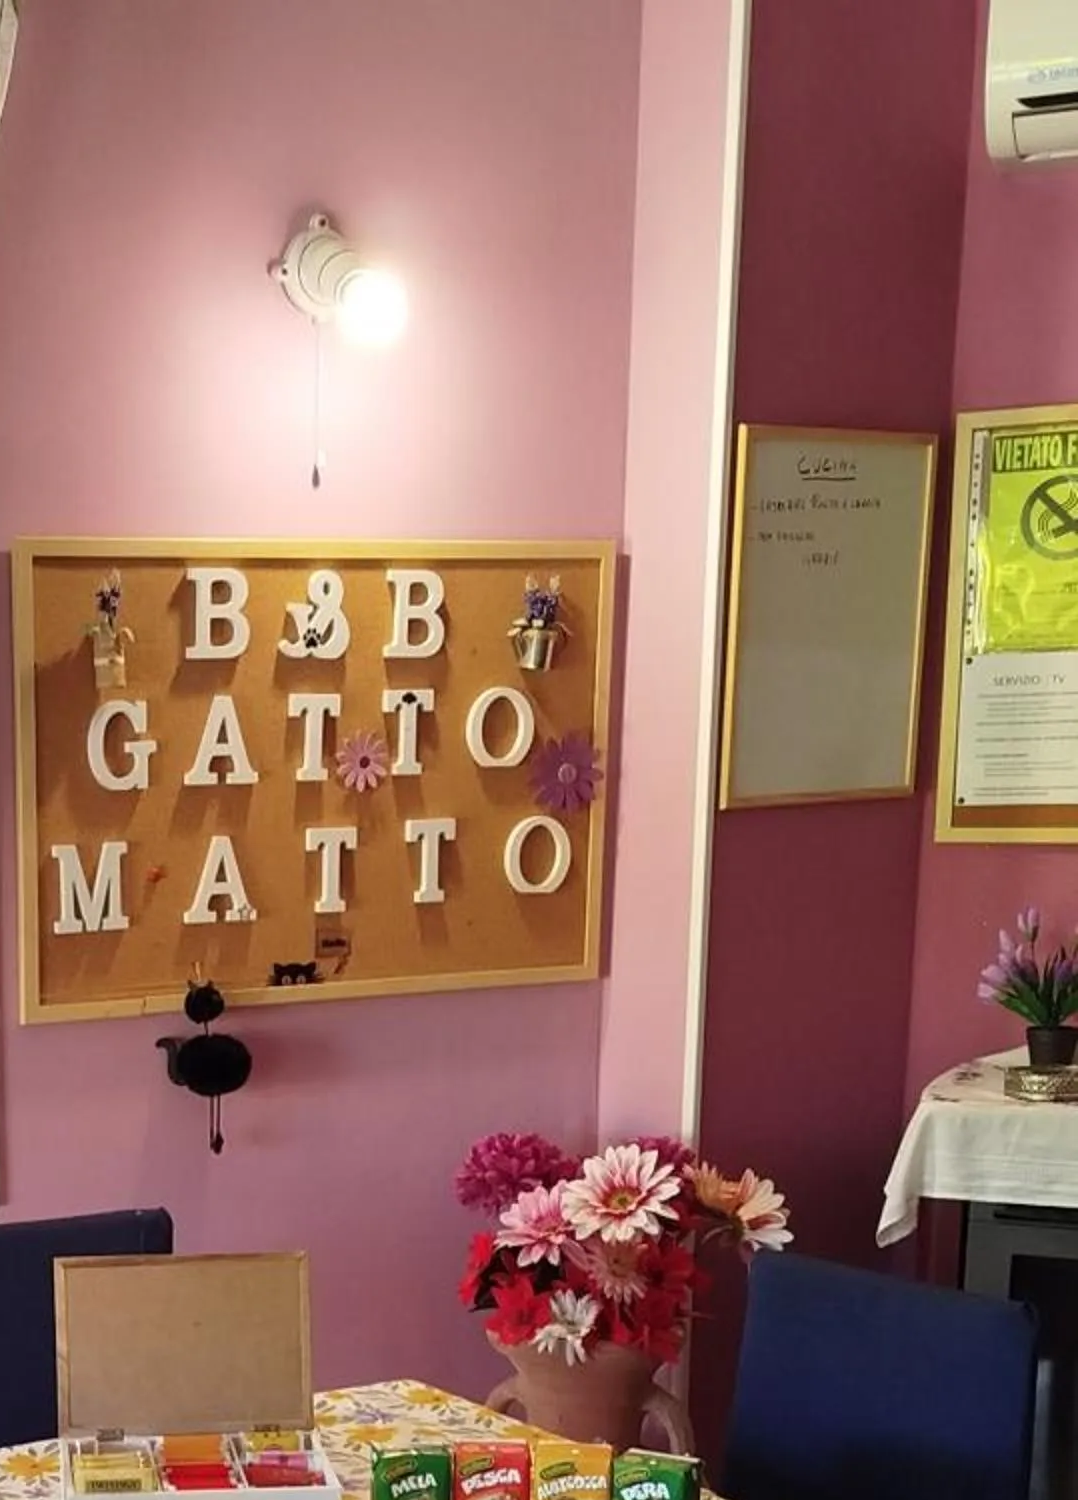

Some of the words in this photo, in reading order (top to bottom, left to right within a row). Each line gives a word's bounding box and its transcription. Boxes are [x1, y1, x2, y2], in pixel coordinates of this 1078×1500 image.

[995, 435, 1062, 471] VIETATO
[993, 674, 1041, 687] SERVIZIO
[86, 686, 536, 791] GATTO
[51, 815, 572, 935] MATTO
[390, 1472, 438, 1498] MELA
[460, 1468, 522, 1496] PESCA
